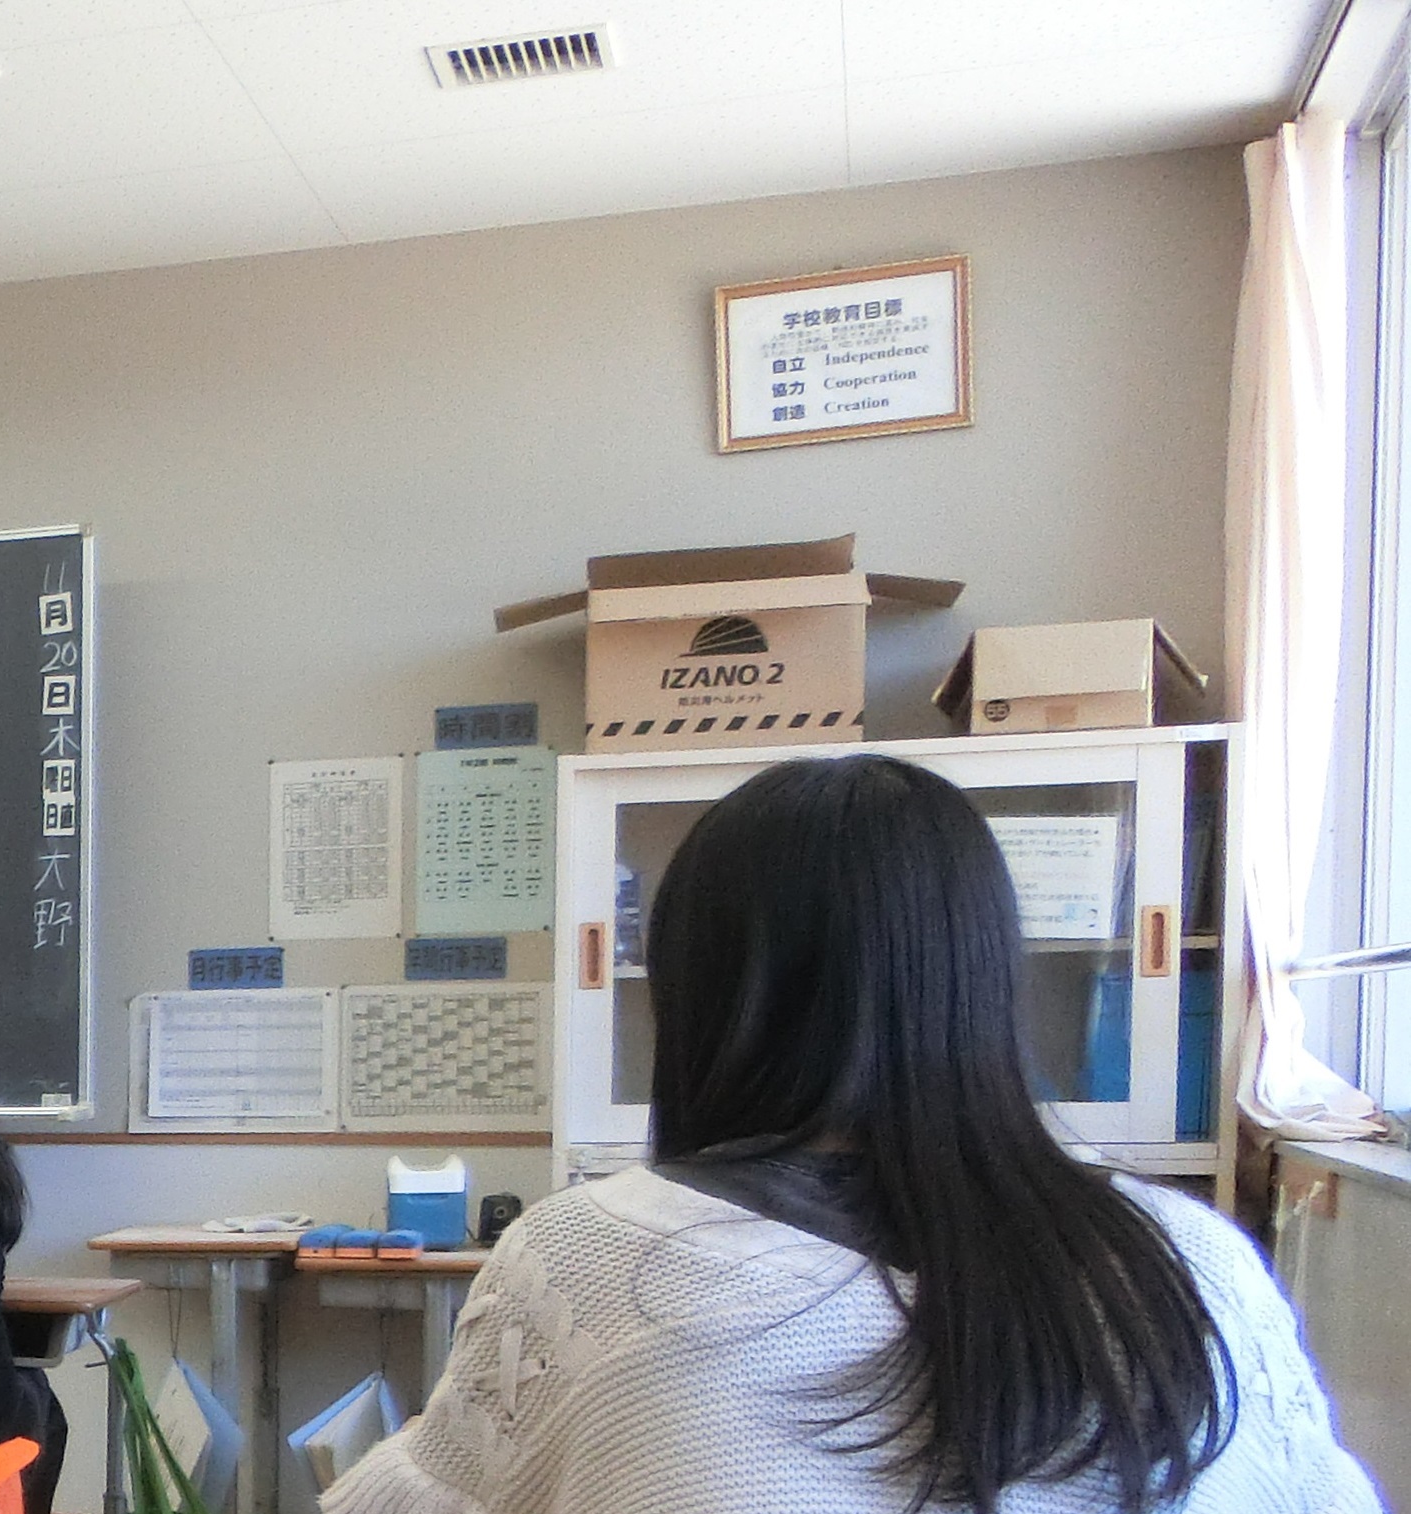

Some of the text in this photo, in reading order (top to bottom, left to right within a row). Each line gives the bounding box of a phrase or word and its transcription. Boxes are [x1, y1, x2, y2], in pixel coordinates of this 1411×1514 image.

[772, 357, 806, 375] 自立
[825, 344, 930, 366] Independence
[772, 369, 918, 398] 協力 Cooperation
[824, 397, 890, 415] Creation
[660, 662, 785, 690] IZANO 2
